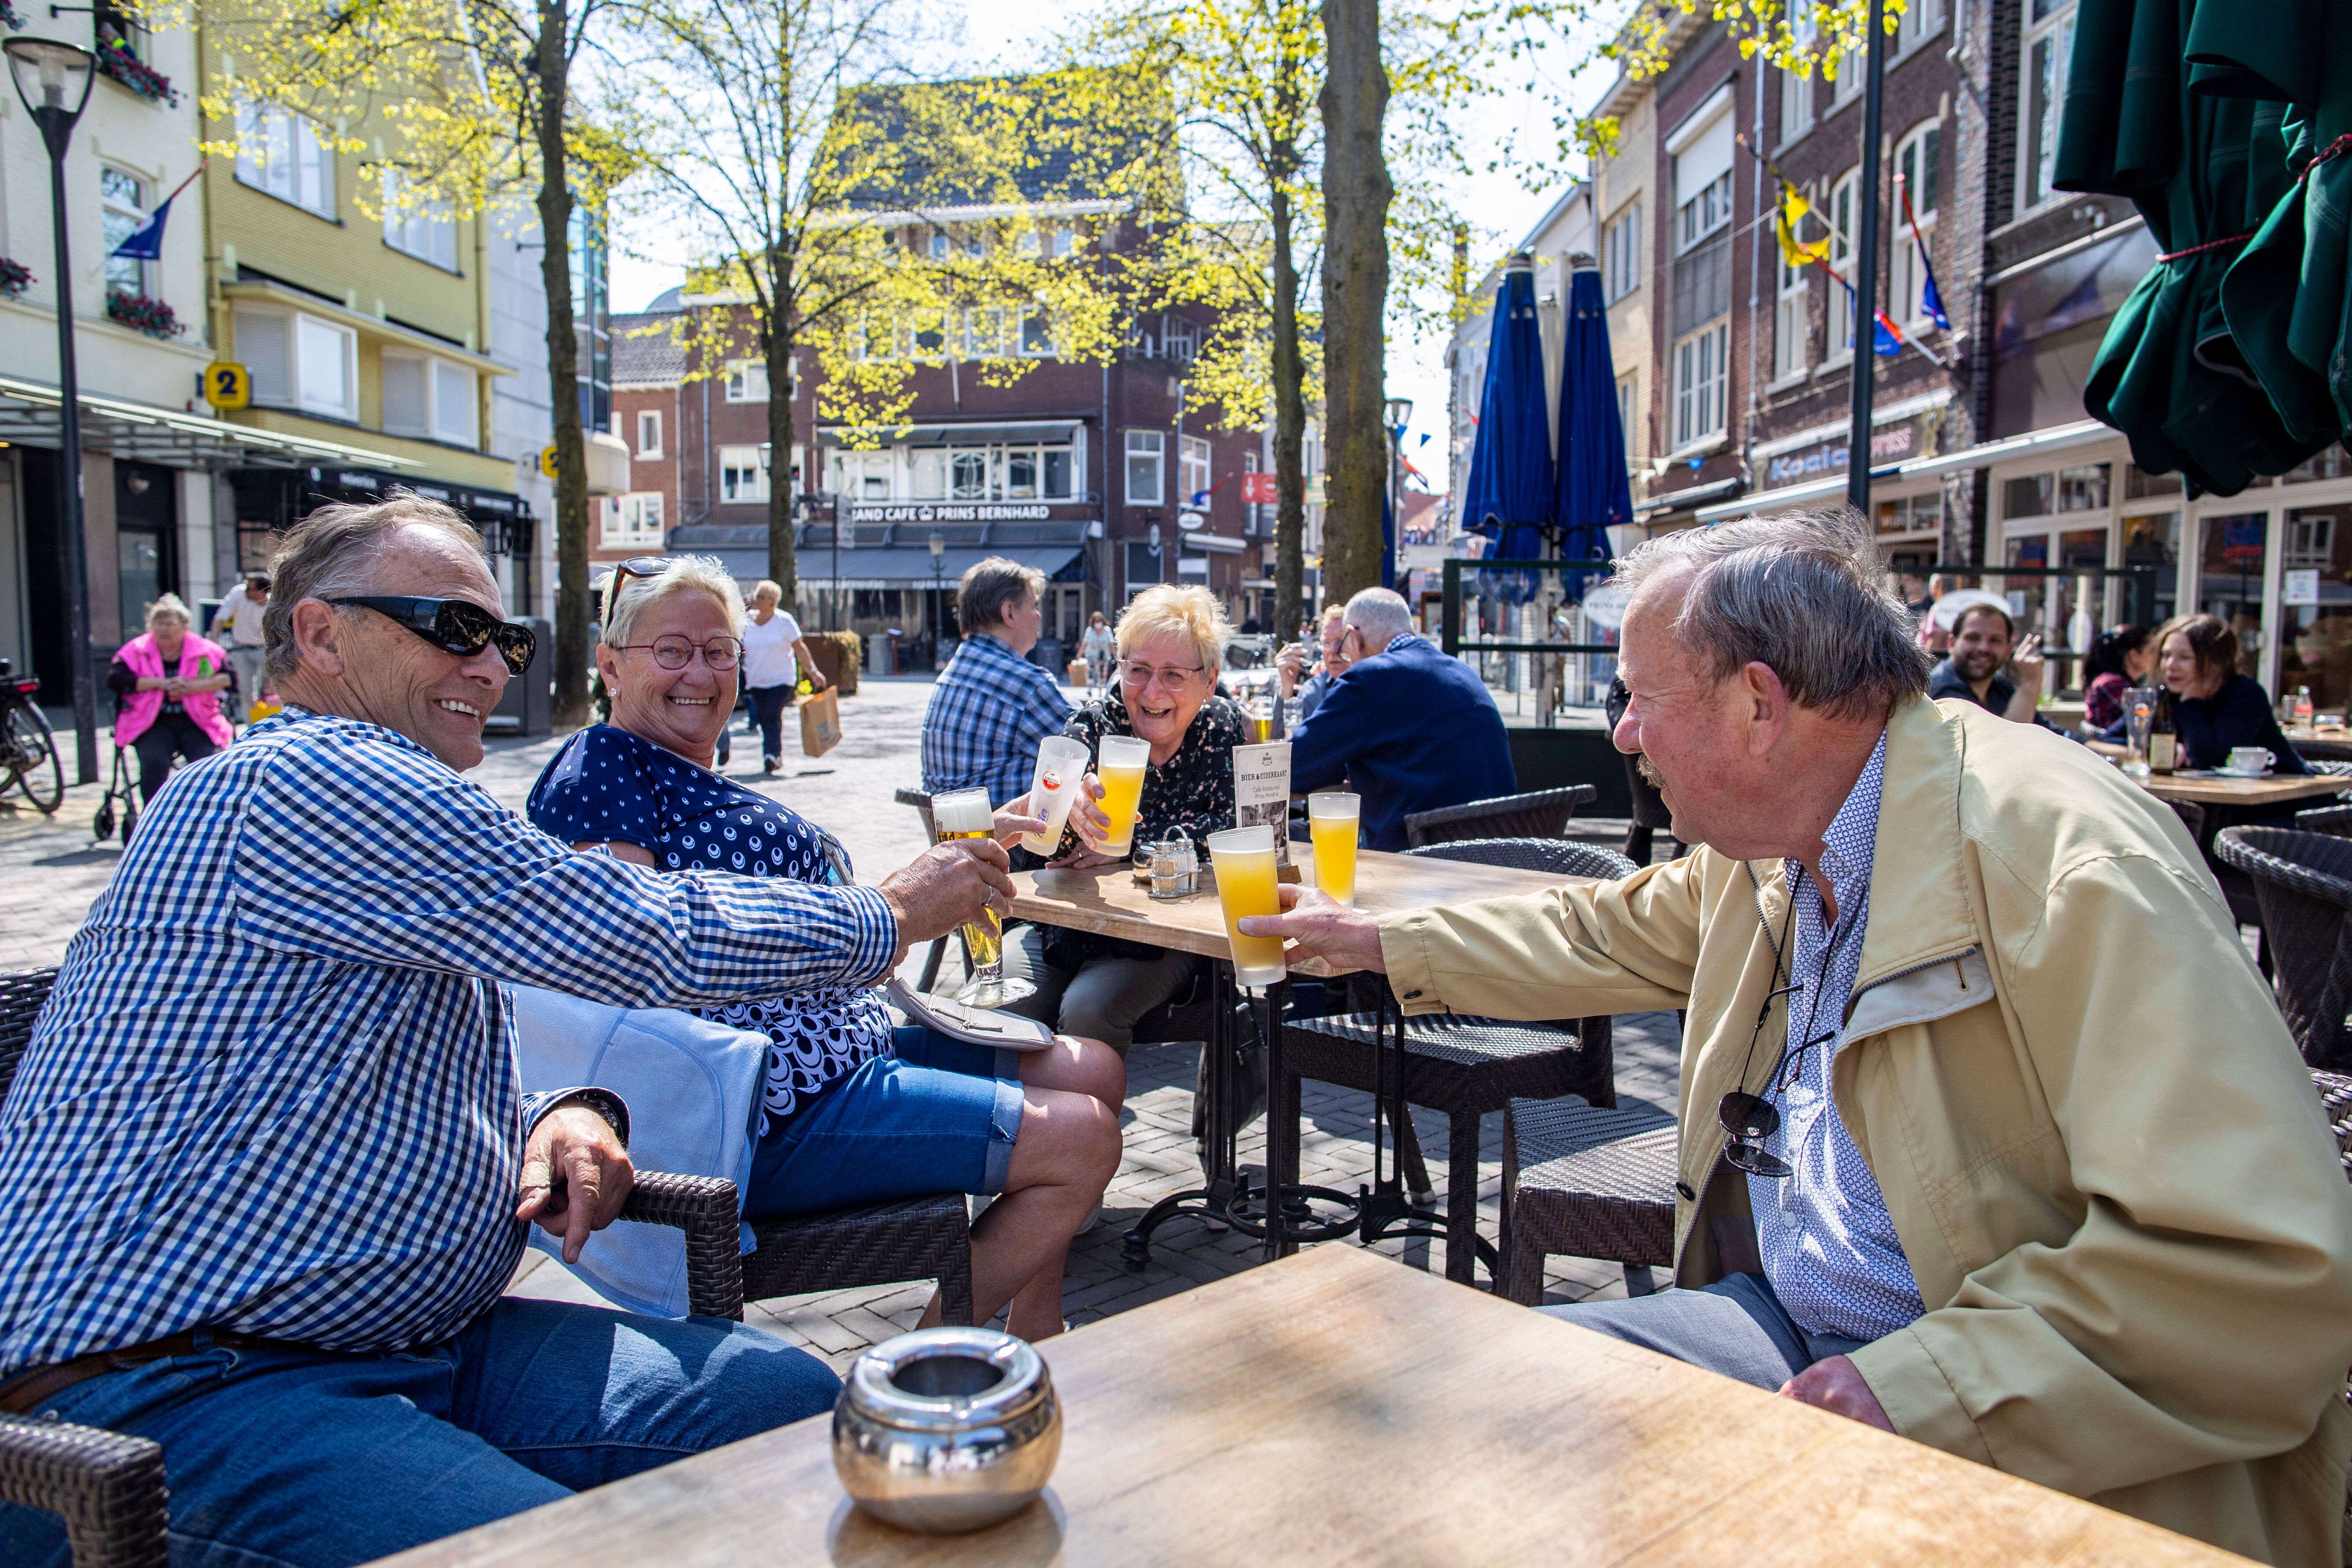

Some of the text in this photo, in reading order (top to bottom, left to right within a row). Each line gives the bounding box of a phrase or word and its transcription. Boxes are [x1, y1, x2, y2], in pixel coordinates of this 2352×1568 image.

[217, 370, 237, 394] 2
[1770, 445, 1849, 481] Koala
[936, 507, 976, 521] PRINS
[977, 506, 1050, 520] BERNHARD
[1261, 770, 1287, 779] CIDERKAART
